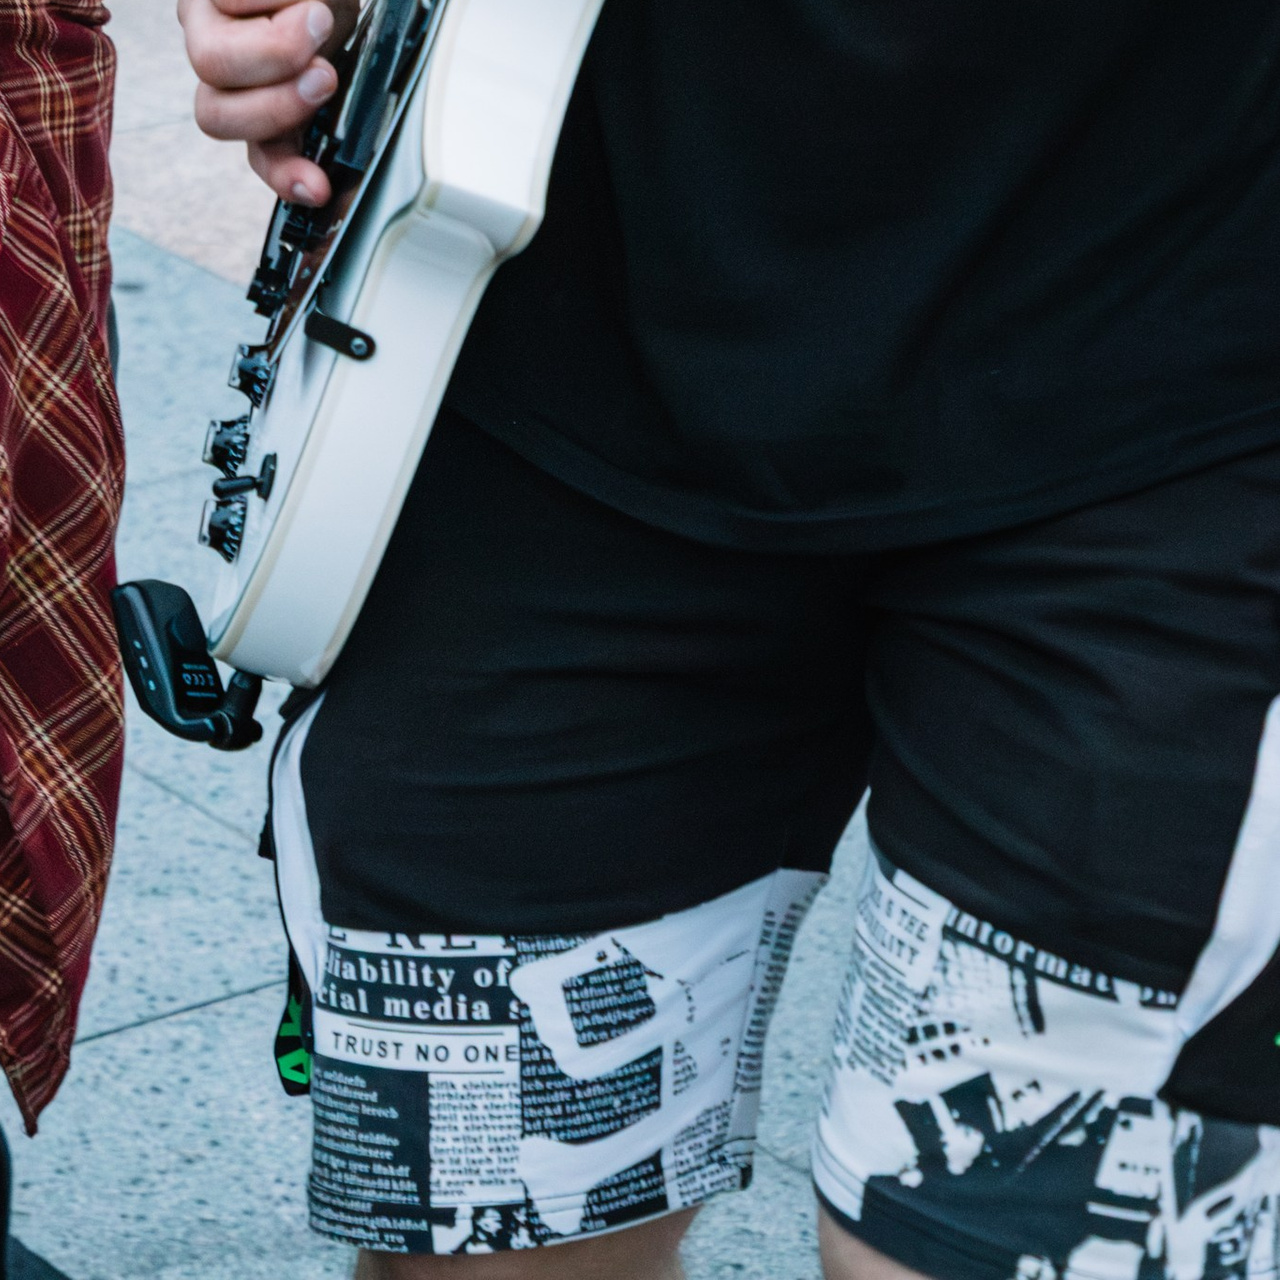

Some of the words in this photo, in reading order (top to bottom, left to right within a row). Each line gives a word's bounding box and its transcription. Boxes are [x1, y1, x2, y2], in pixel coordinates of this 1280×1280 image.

[473, 958, 511, 988] of
[383, 994, 492, 1021] media
[332, 1032, 404, 1060] TRUST
[416, 1044, 450, 1062] NO
[464, 1045, 520, 1062] ONE
